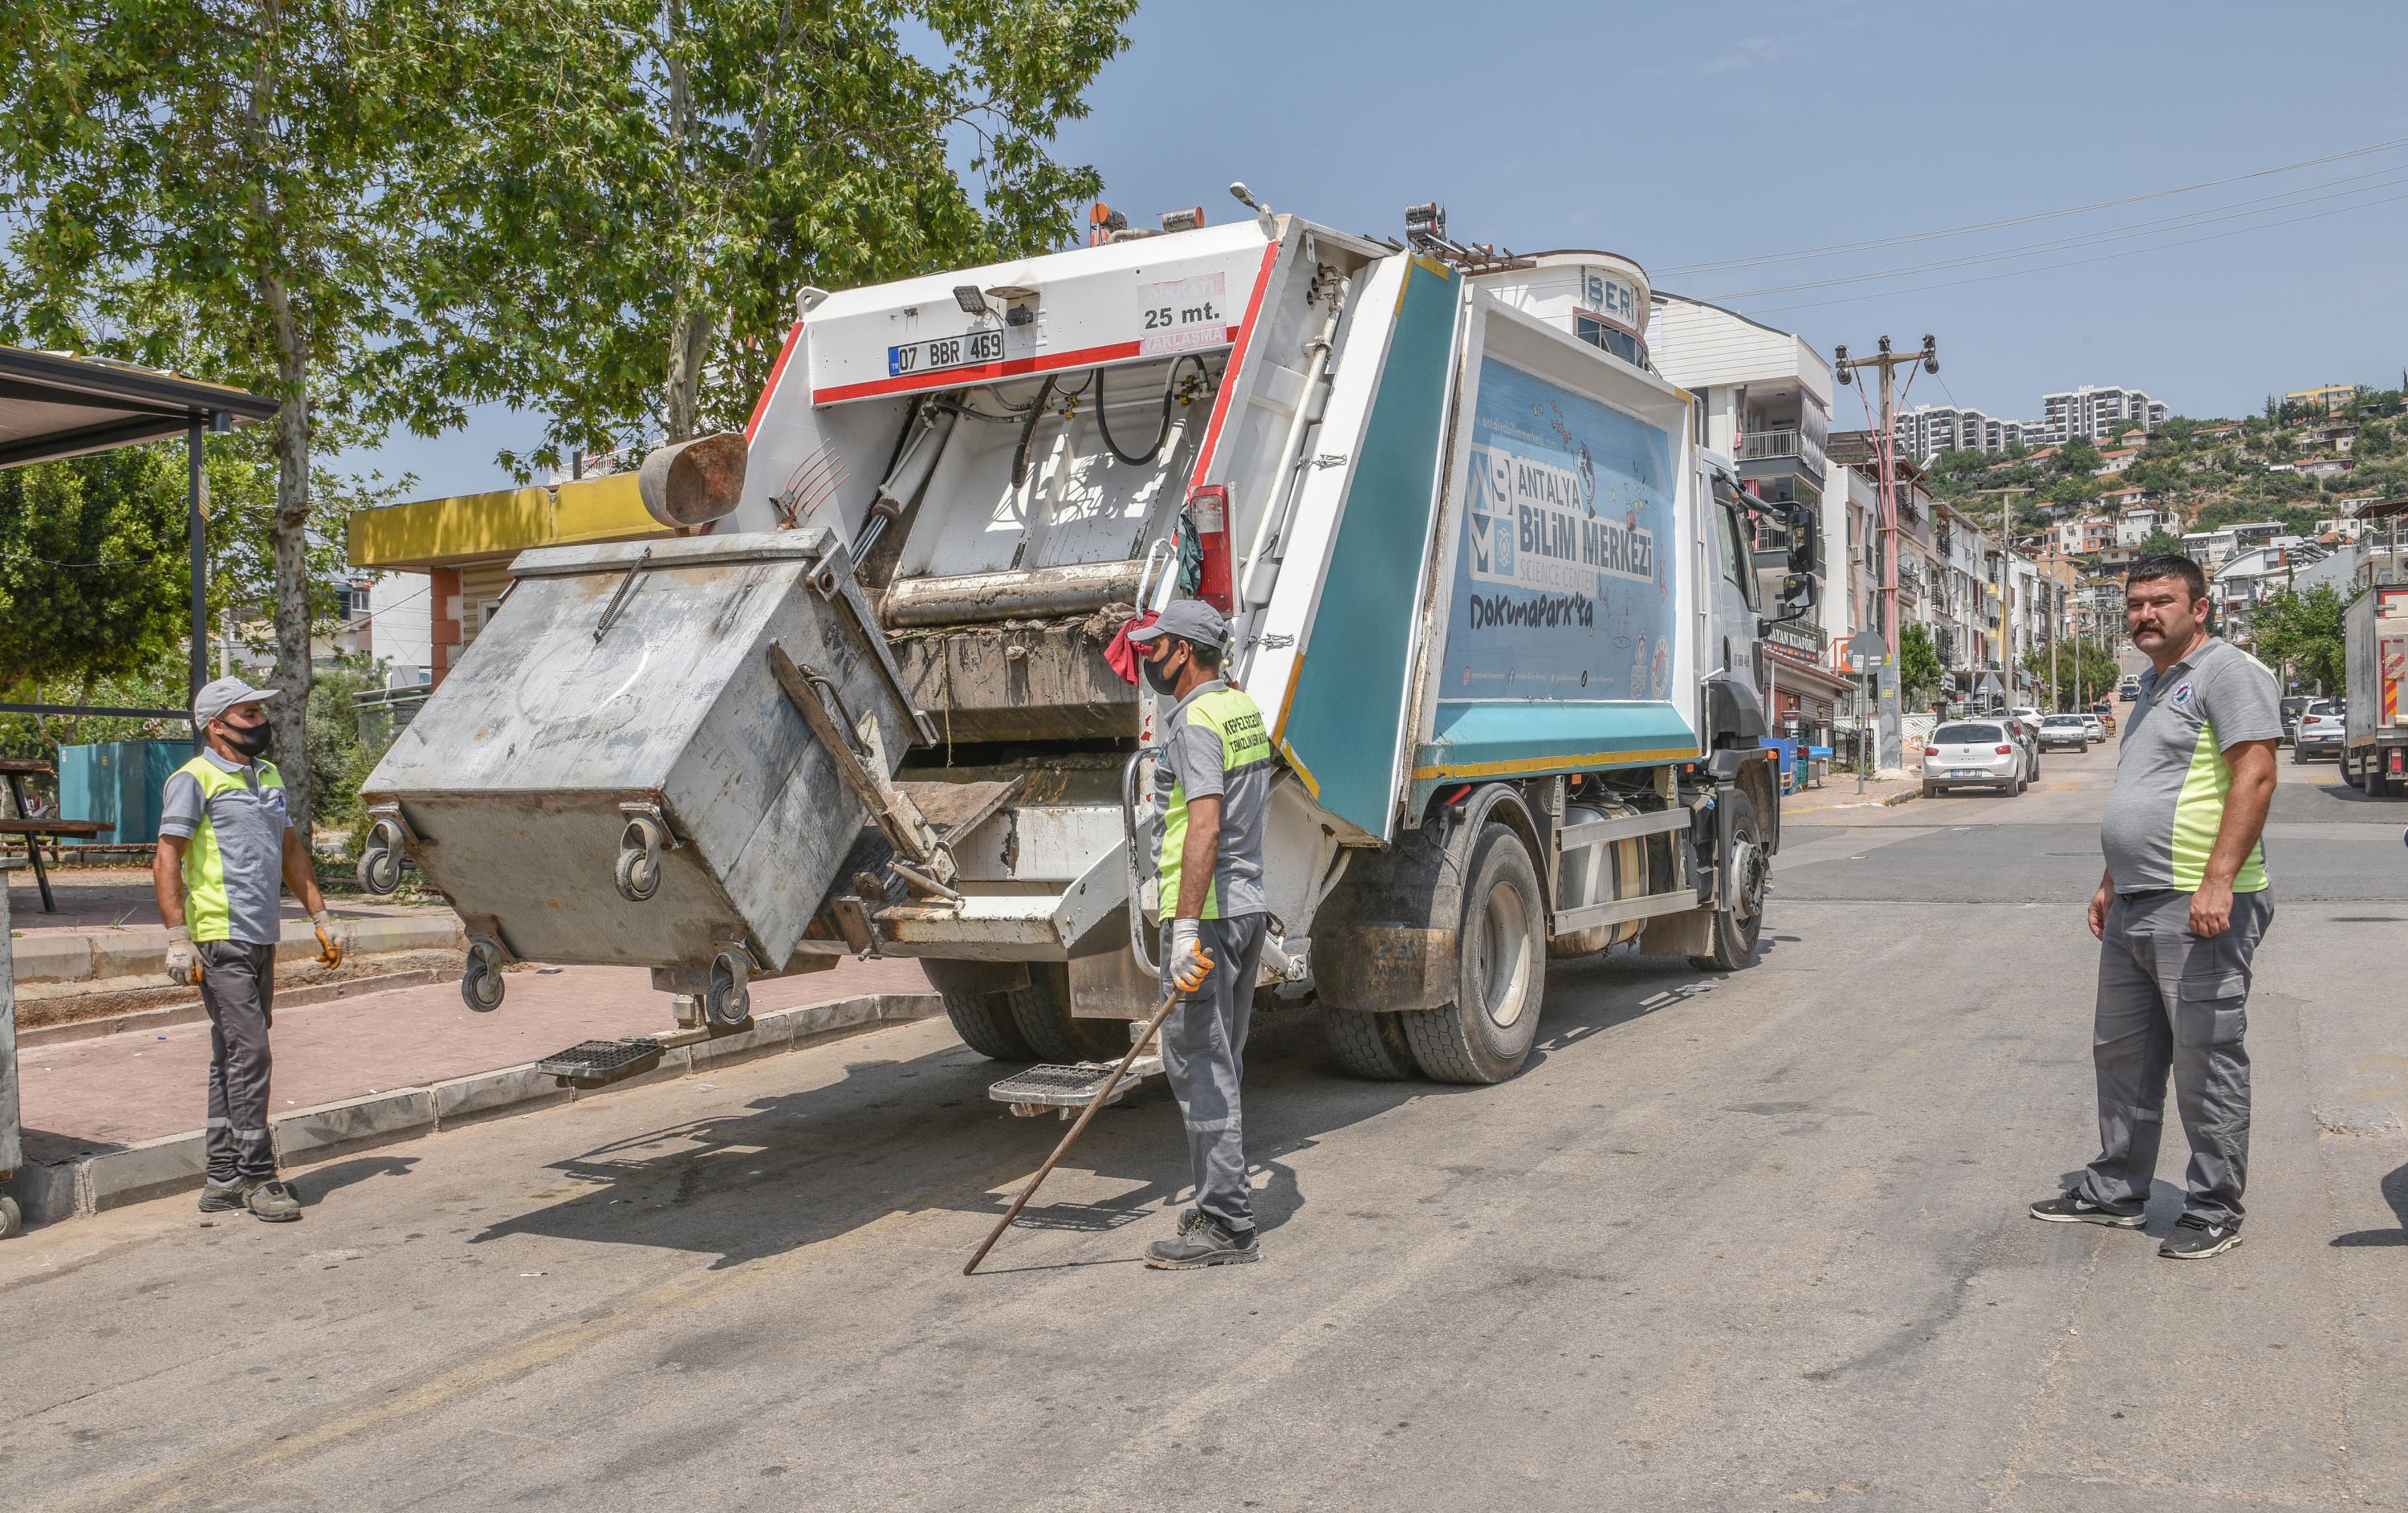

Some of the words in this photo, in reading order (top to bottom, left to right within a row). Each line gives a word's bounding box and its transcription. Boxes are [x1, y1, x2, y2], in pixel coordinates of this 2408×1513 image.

[1145, 307, 1173, 330] 25
[1182, 302, 1220, 323] mt.
[899, 347, 917, 371] 07
[930, 340, 960, 366] BBR
[970, 334, 1001, 359] 469
[1519, 464, 1581, 510] ANTALYA
[1519, 504, 1576, 562] BİLİM
[1582, 519, 1652, 577] MERKEZİ
[1519, 559, 1560, 586] SCIENCE
[1562, 565, 1596, 592] CENTER
[1788, 632, 1817, 653] KUAFÖRÜ
[1222, 717, 1247, 736] KEPEZ
